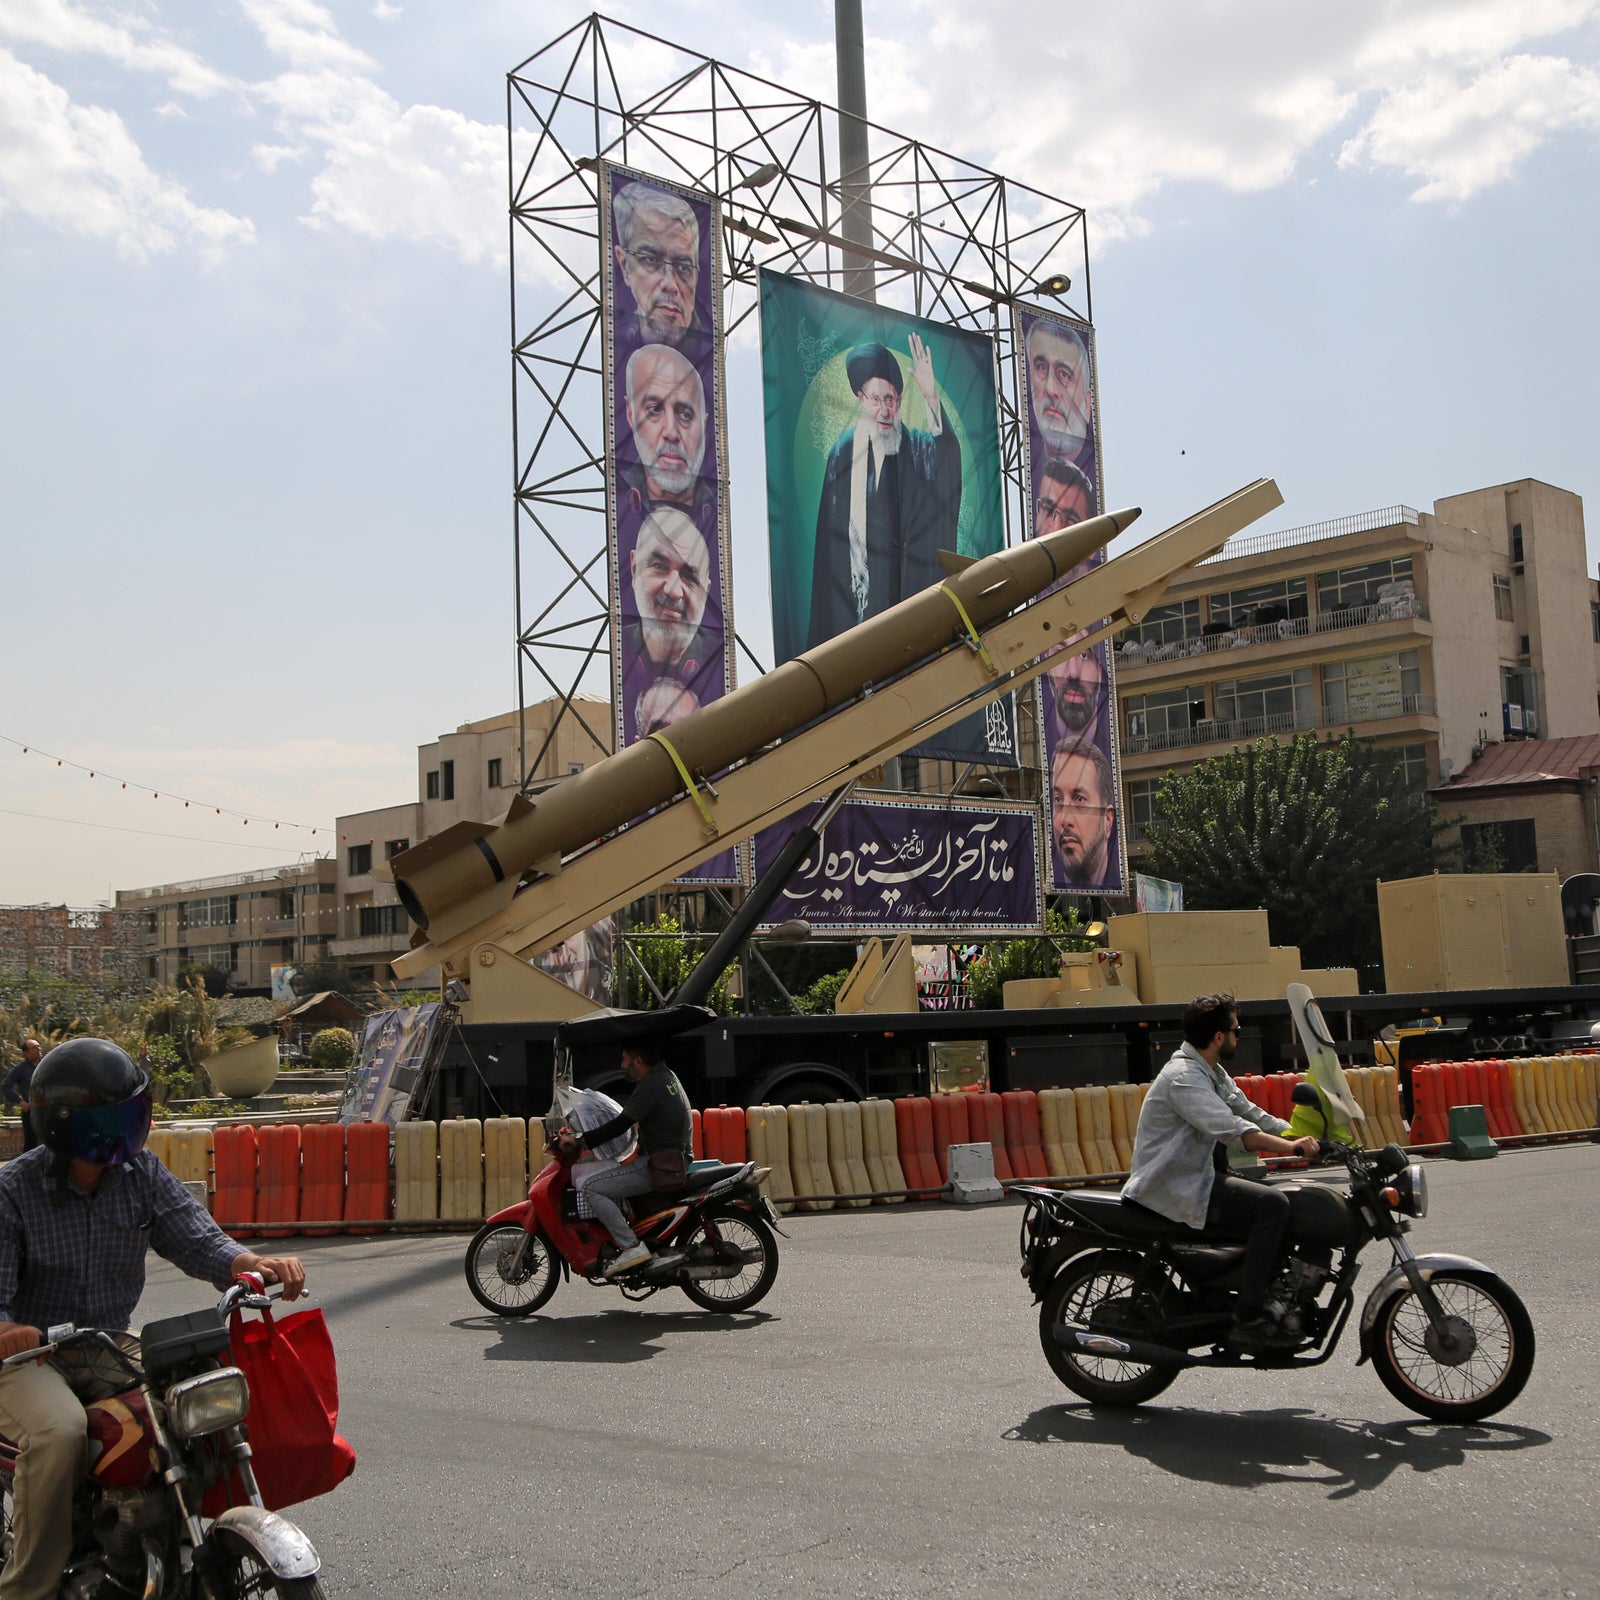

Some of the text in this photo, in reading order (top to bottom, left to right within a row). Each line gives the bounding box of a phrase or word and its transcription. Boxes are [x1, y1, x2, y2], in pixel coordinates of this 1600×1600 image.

[874, 829, 919, 865] خمینی
[907, 840, 924, 860] امام
[932, 816, 999, 897] آخر
[989, 839, 1008, 882] تا
[824, 831, 951, 902] ایستاده
[1002, 856, 1014, 882] ما
[794, 903, 829, 917] Imam
[832, 903, 881, 917] Khomeini
[896, 901, 922, 918] We
[918, 907, 960, 922] stand-up
[961, 908, 970, 917] to
[972, 906, 984, 917] the
